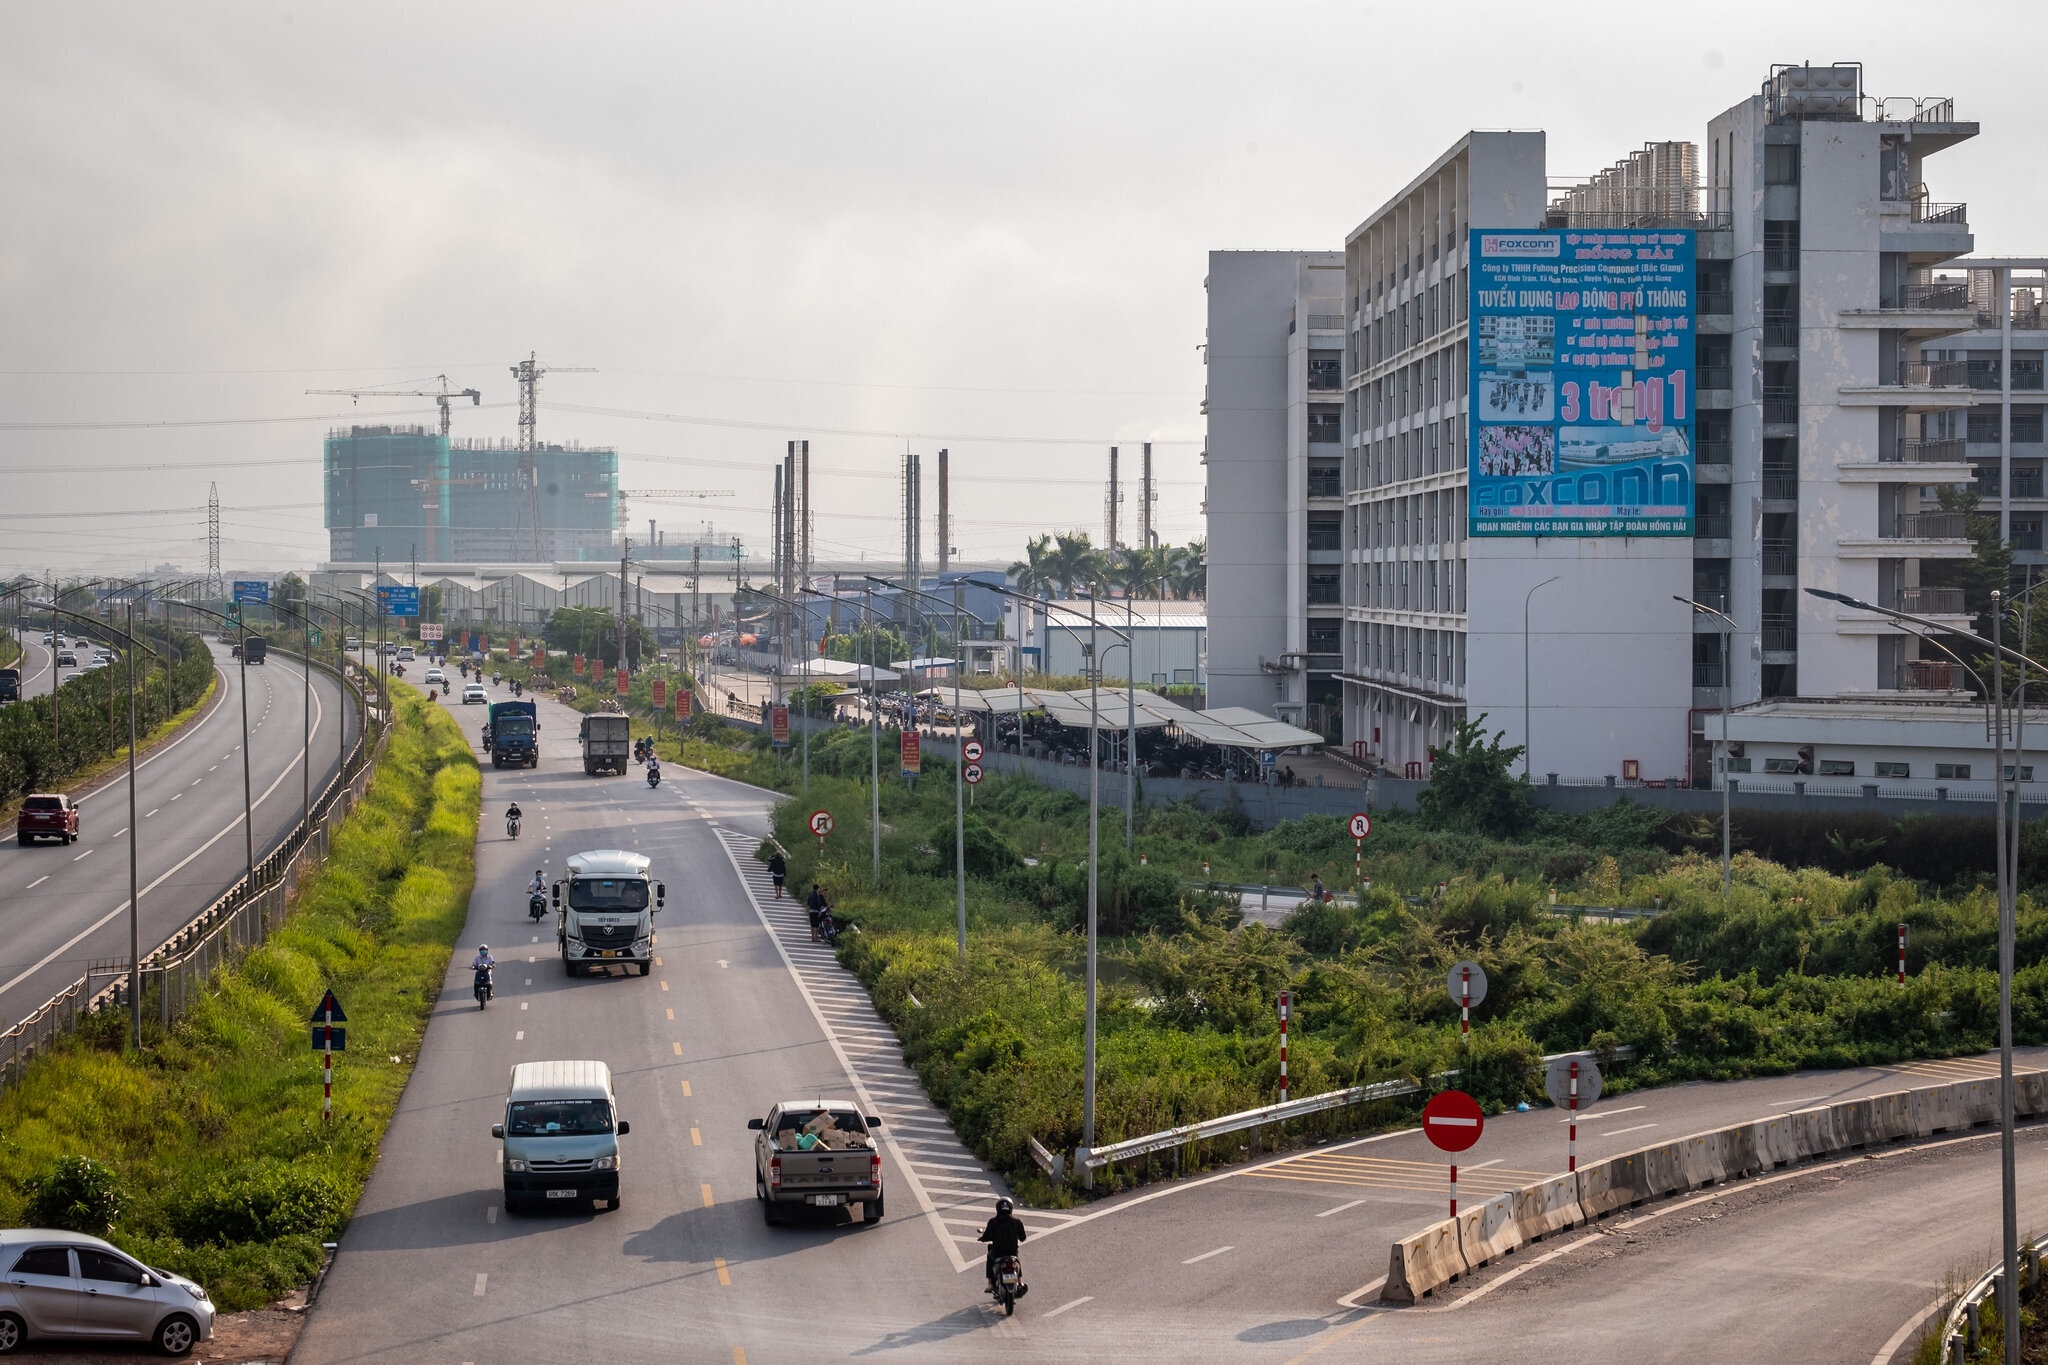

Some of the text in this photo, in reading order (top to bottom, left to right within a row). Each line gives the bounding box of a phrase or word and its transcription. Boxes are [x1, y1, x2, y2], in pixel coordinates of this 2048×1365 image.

[1482, 264, 1500, 272] Công
[1502, 264, 1509, 272] ty
[1660, 264, 1684, 272] Giang)
[1478, 284, 1516, 307] TUYỂN
[1520, 290, 1552, 311] DỤNG
[1556, 291, 1580, 310] LAO
[1582, 287, 1618, 311] ĐỘNG
[1647, 287, 1686, 307] THÔNG
[1561, 370, 1685, 433] 3 trong 1
[1477, 522, 1498, 532] HOAN
[1500, 520, 1532, 532] NGHÊNH
[1534, 520, 1550, 531] CÁC
[1552, 522, 1568, 532] BẠN
[1570, 522, 1584, 531] GIA
[1586, 520, 1606, 533] NHẬP
[1610, 520, 1624, 532] TẬP
[1626, 520, 1648, 531] ĐOÀN
[1264, 752, 1272, 761] P
